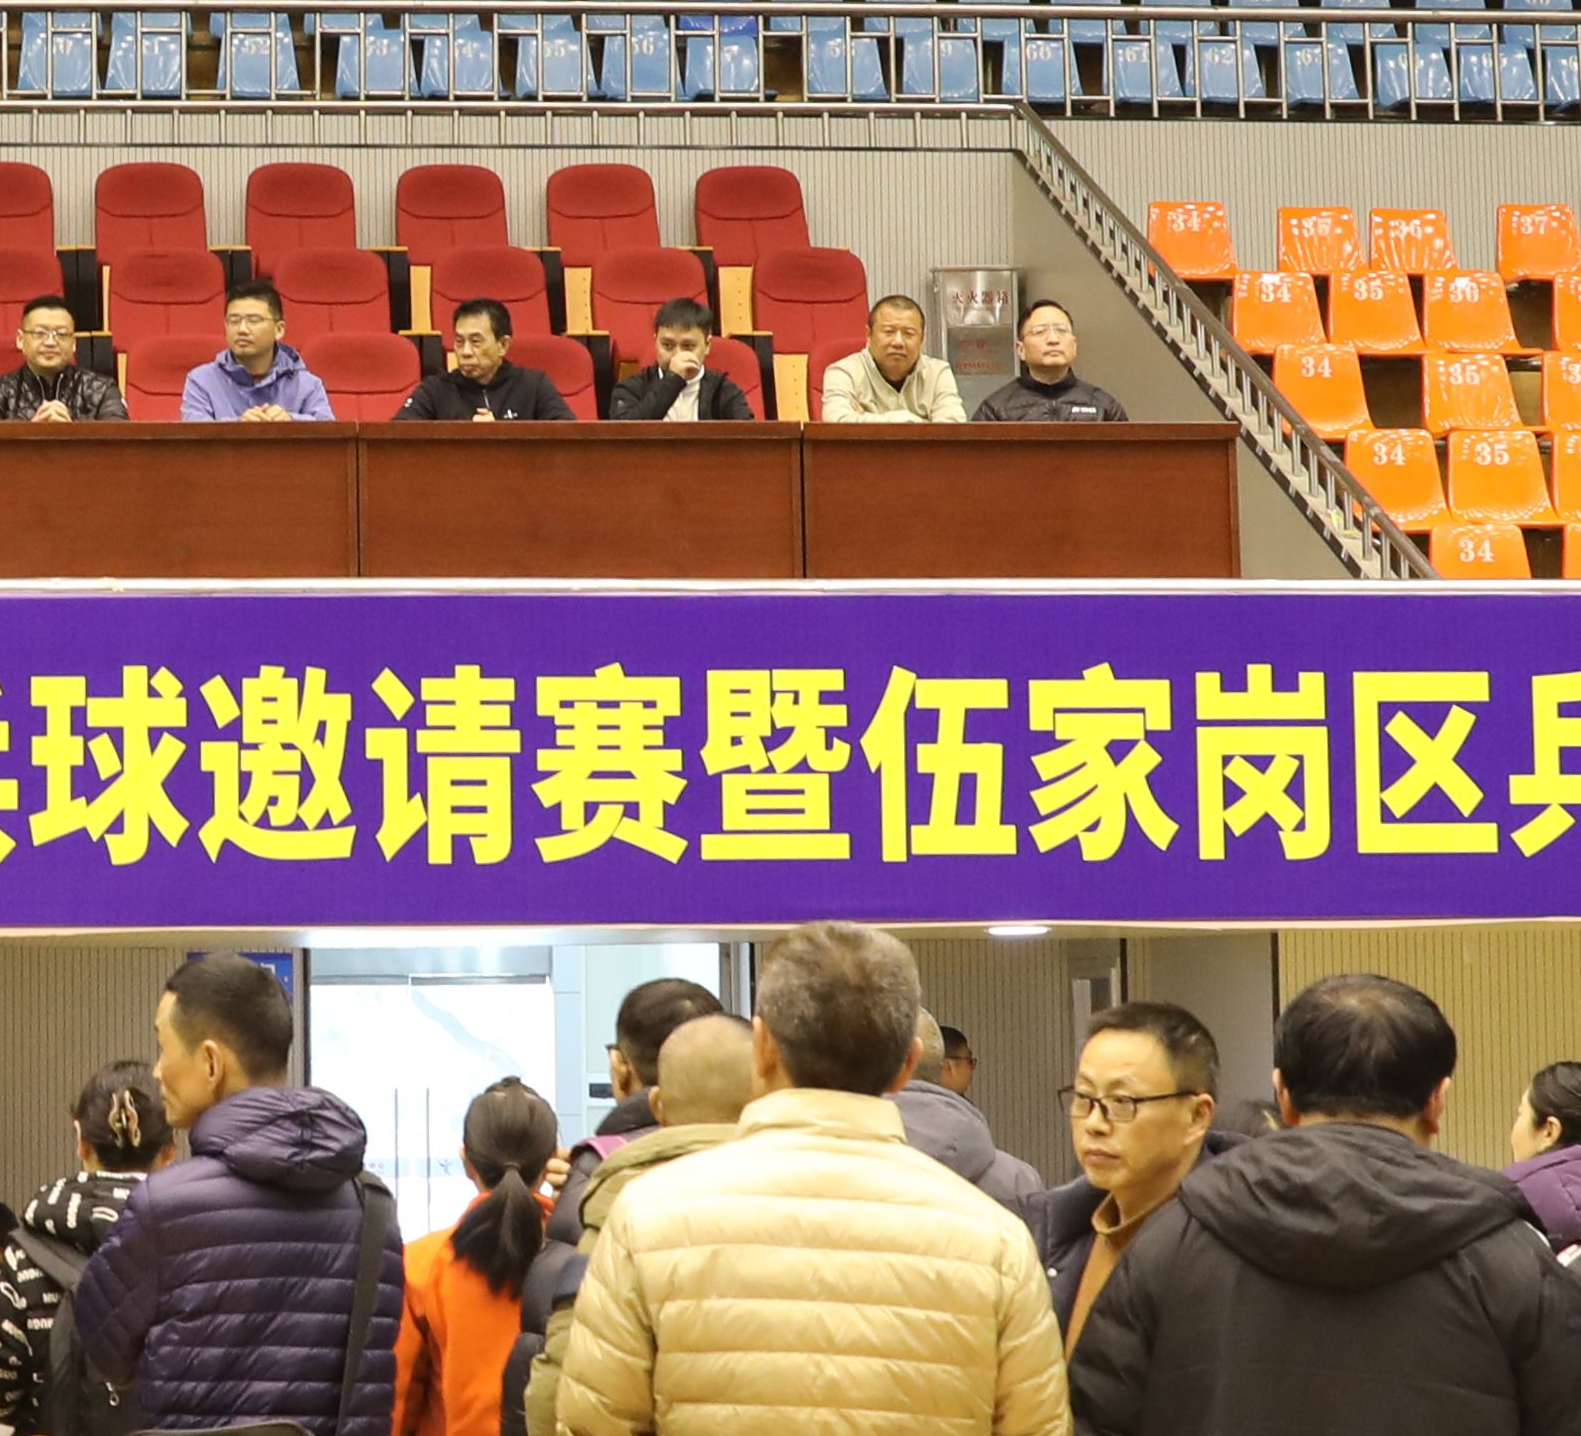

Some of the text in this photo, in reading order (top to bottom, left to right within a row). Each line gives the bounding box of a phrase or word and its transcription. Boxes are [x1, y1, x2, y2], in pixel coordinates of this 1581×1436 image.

[1172, 213, 1200, 231] 34
[1521, 216, 1548, 234] 37
[1355, 281, 1383, 300] 35
[1301, 357, 1331, 377] 34
[1373, 444, 1405, 466] 34
[1476, 444, 1509, 465] 35
[1460, 540, 1494, 562] 34
